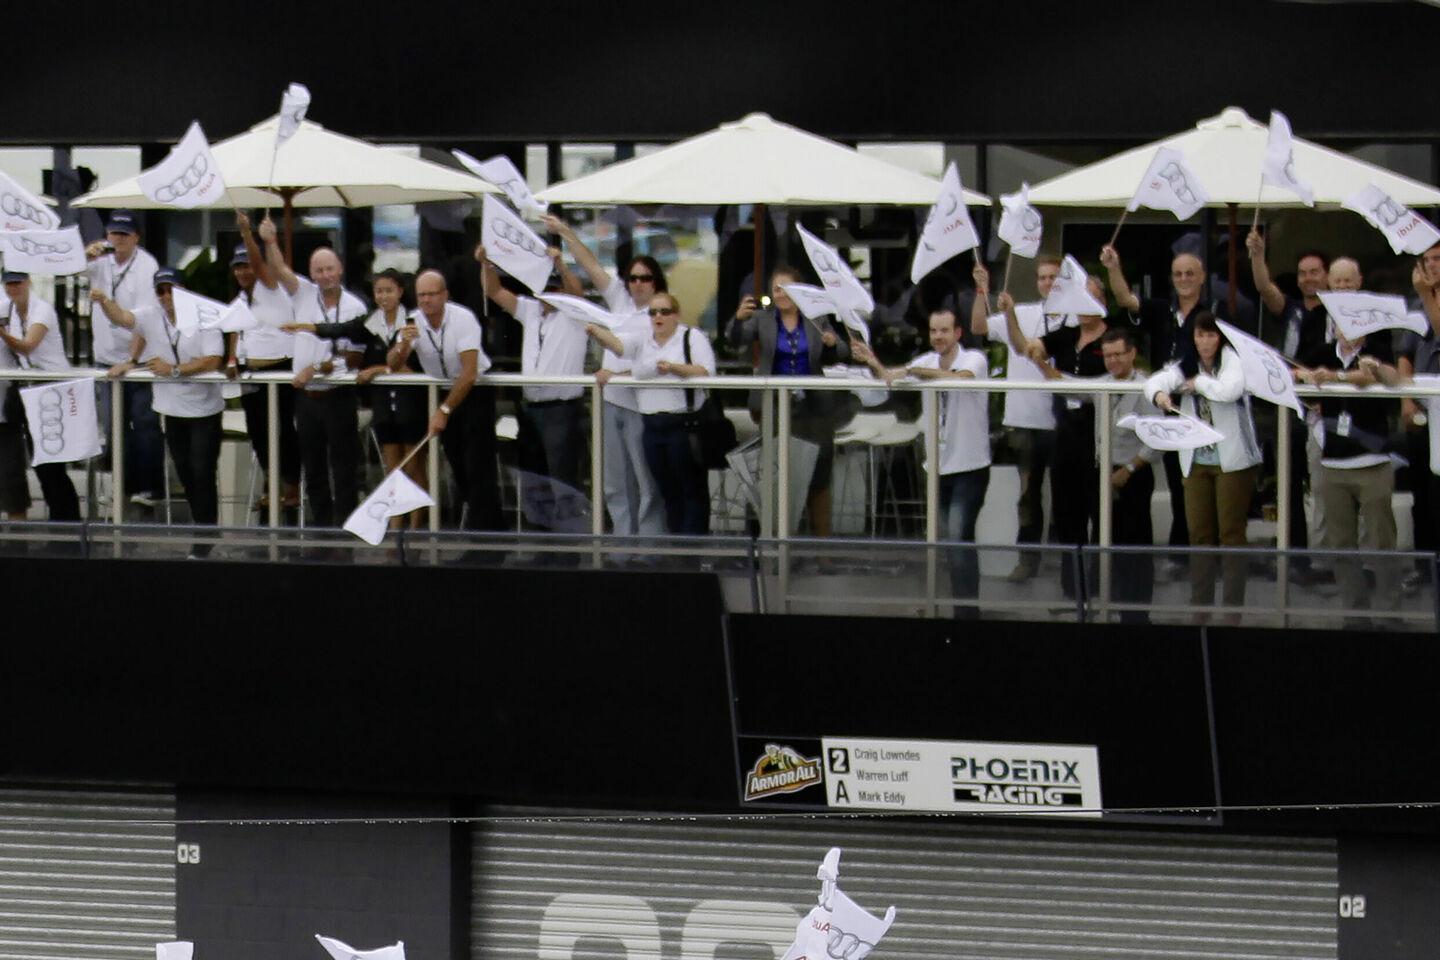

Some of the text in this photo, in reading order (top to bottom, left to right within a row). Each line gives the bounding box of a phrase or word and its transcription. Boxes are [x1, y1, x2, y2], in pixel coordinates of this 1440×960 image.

[831, 750, 847, 772] 2
[854, 749, 921, 762] Craig Lowndes
[750, 765, 816, 793] ARMORALL
[856, 770, 909, 782] Warren Luff
[950, 756, 1080, 784] PHOENIX
[835, 780, 850, 804] A
[858, 791, 906, 806] Mark Eddy
[953, 783, 1083, 807] RACING
[177, 843, 200, 864] 03
[1339, 894, 1366, 918] 02
